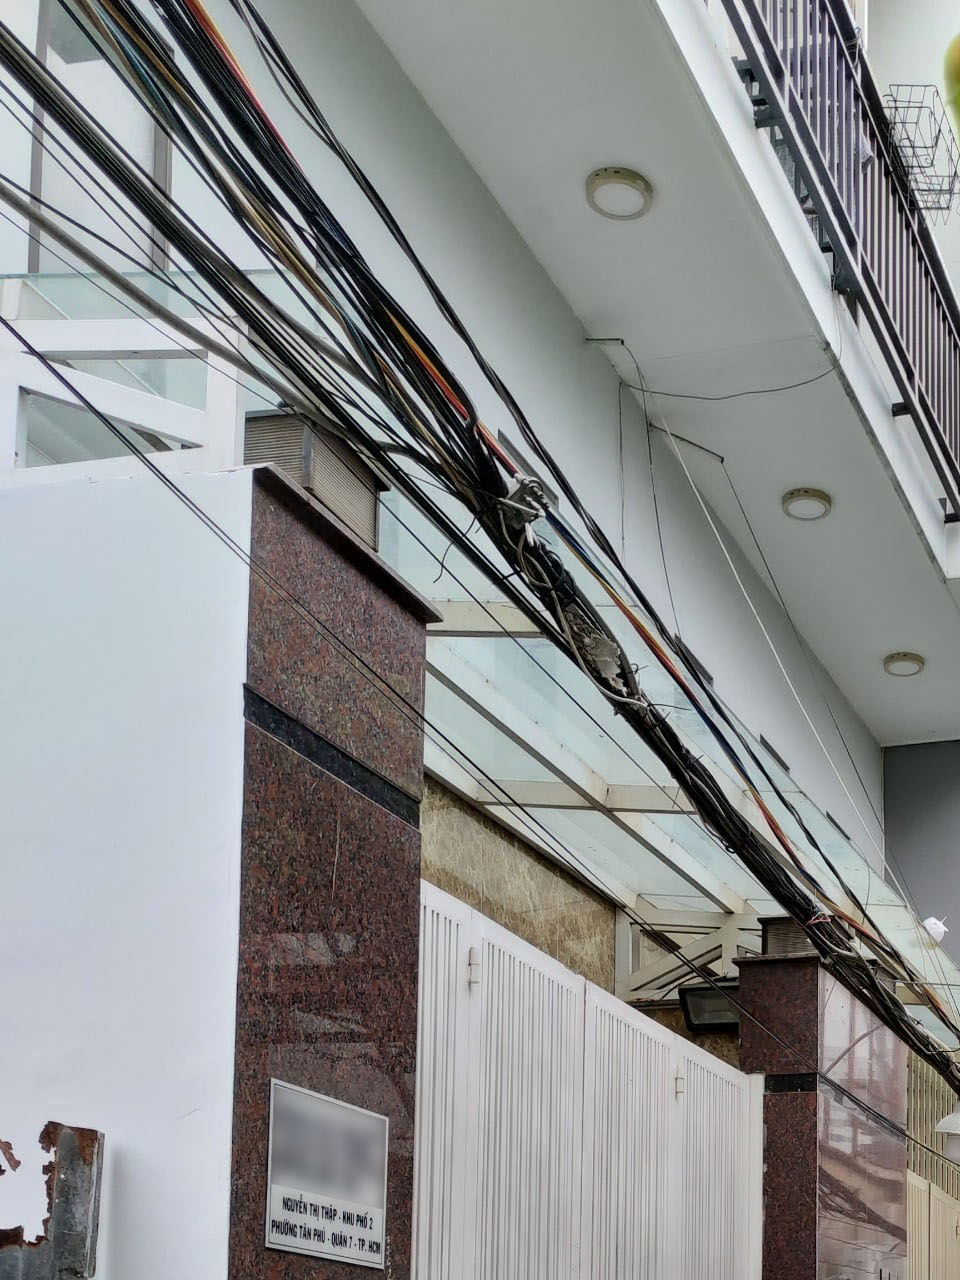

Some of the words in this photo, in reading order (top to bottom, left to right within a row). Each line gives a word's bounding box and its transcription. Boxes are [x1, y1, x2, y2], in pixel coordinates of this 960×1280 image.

[282, 1193, 308, 1215] NGUYỄN
[309, 1203, 320, 1221] THỊ
[321, 1204, 337, 1224] THẬP
[342, 1211, 355, 1226] KHU
[355, 1211, 368, 1229] PHỐ
[369, 1217, 374, 1230] 2
[271, 1219, 298, 1238] PHƯỜNG
[299, 1222, 312, 1241] TÂN
[313, 1226, 326, 1244] PHÚ
[331, 1230, 348, 1249] QUẬN
[349, 1236, 353, 1249] 7
[358, 1238, 367, 1252] TP.
[368, 1242, 381, 1255] HCM
